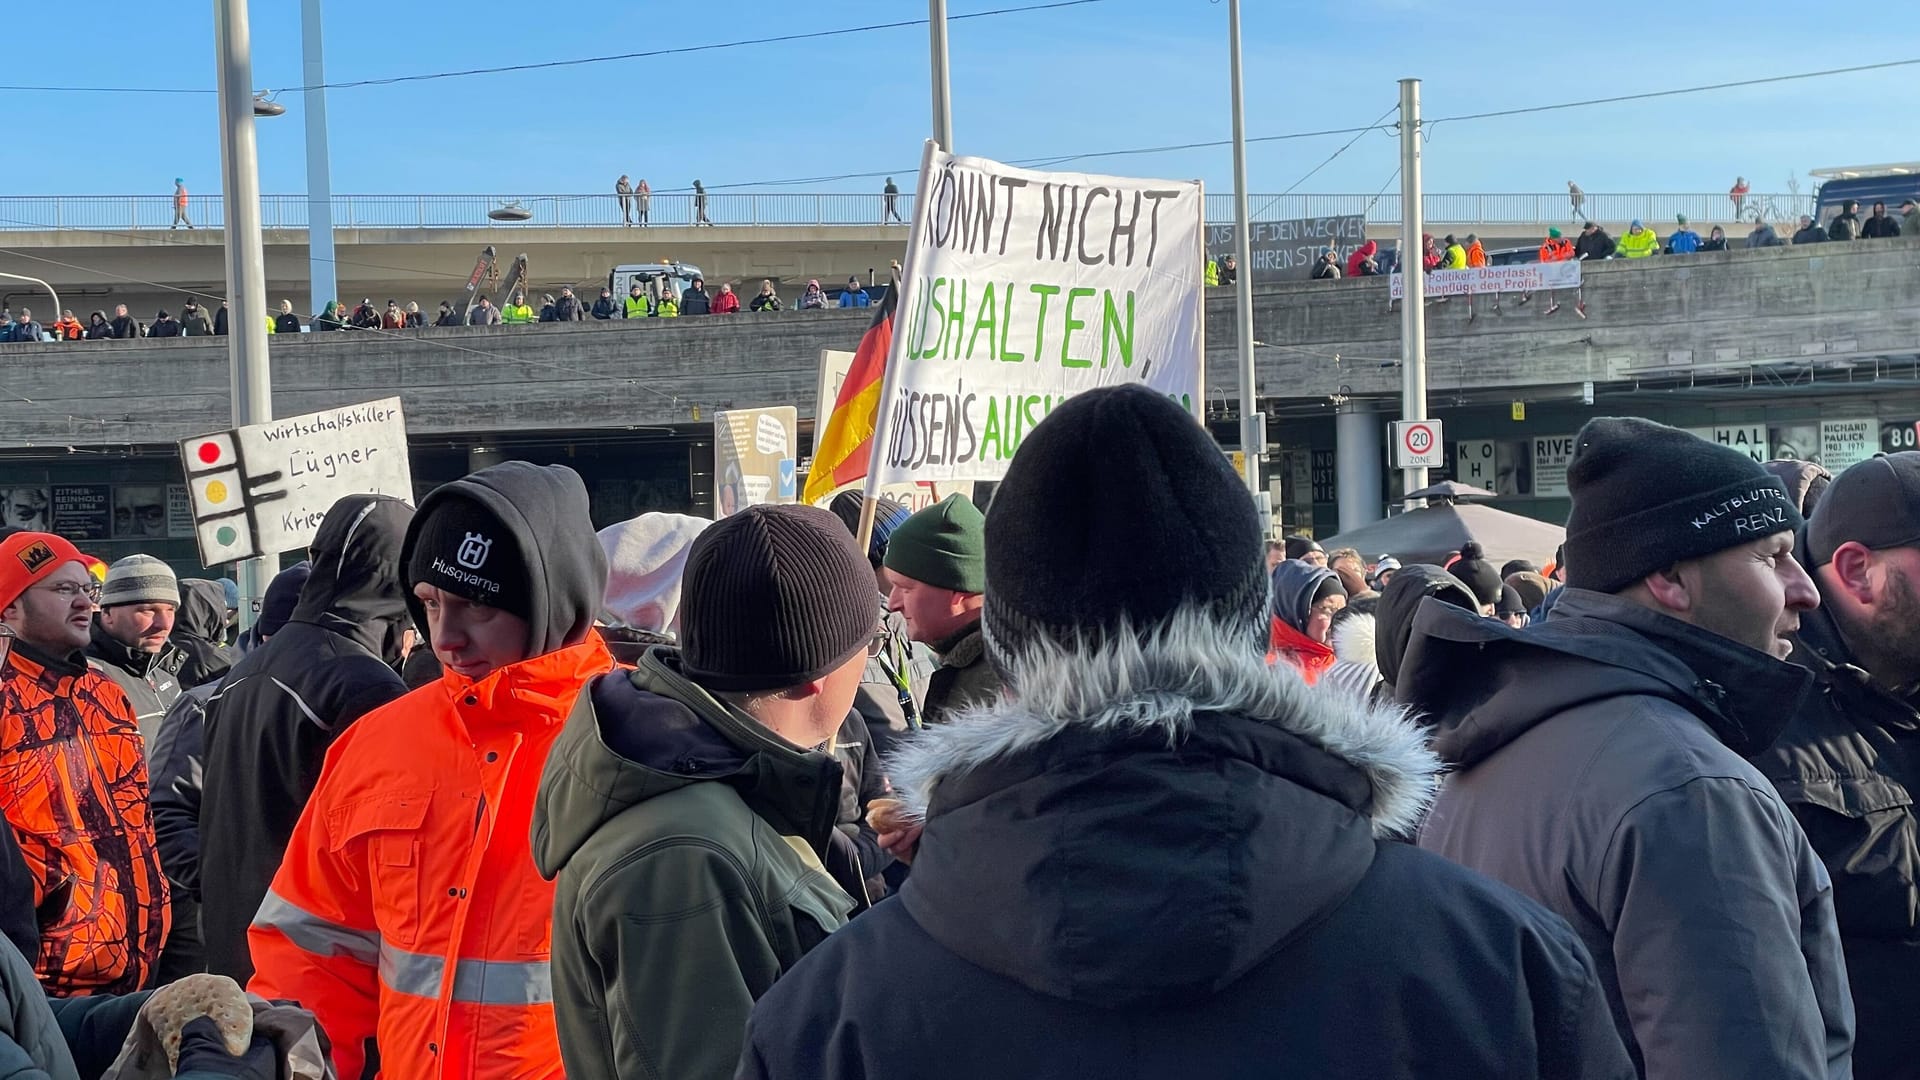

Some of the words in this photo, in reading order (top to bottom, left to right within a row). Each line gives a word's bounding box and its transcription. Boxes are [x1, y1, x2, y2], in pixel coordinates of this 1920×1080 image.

[1036, 182, 1180, 267] NICHT
[1269, 221, 1298, 241] DEN
[1302, 217, 1365, 239] WECKER
[1253, 249, 1293, 270] IHREN
[1429, 271, 1475, 283] Politiker:
[1479, 267, 1537, 280] Überlasst
[1480, 280, 1500, 291] den
[1505, 273, 1543, 289] Profis!
[1824, 423, 1867, 433] RICHARD
[1412, 433, 1428, 447] 20
[1824, 432, 1865, 442] PAULICK
[1537, 439, 1572, 456] RIVE
[290, 447, 378, 478] Lügner
[1410, 455, 1432, 464] ZONE
[55, 495, 105, 503] REINHOLD
[1735, 507, 1788, 535] RENZ
[431, 556, 501, 593] Husqvarna
